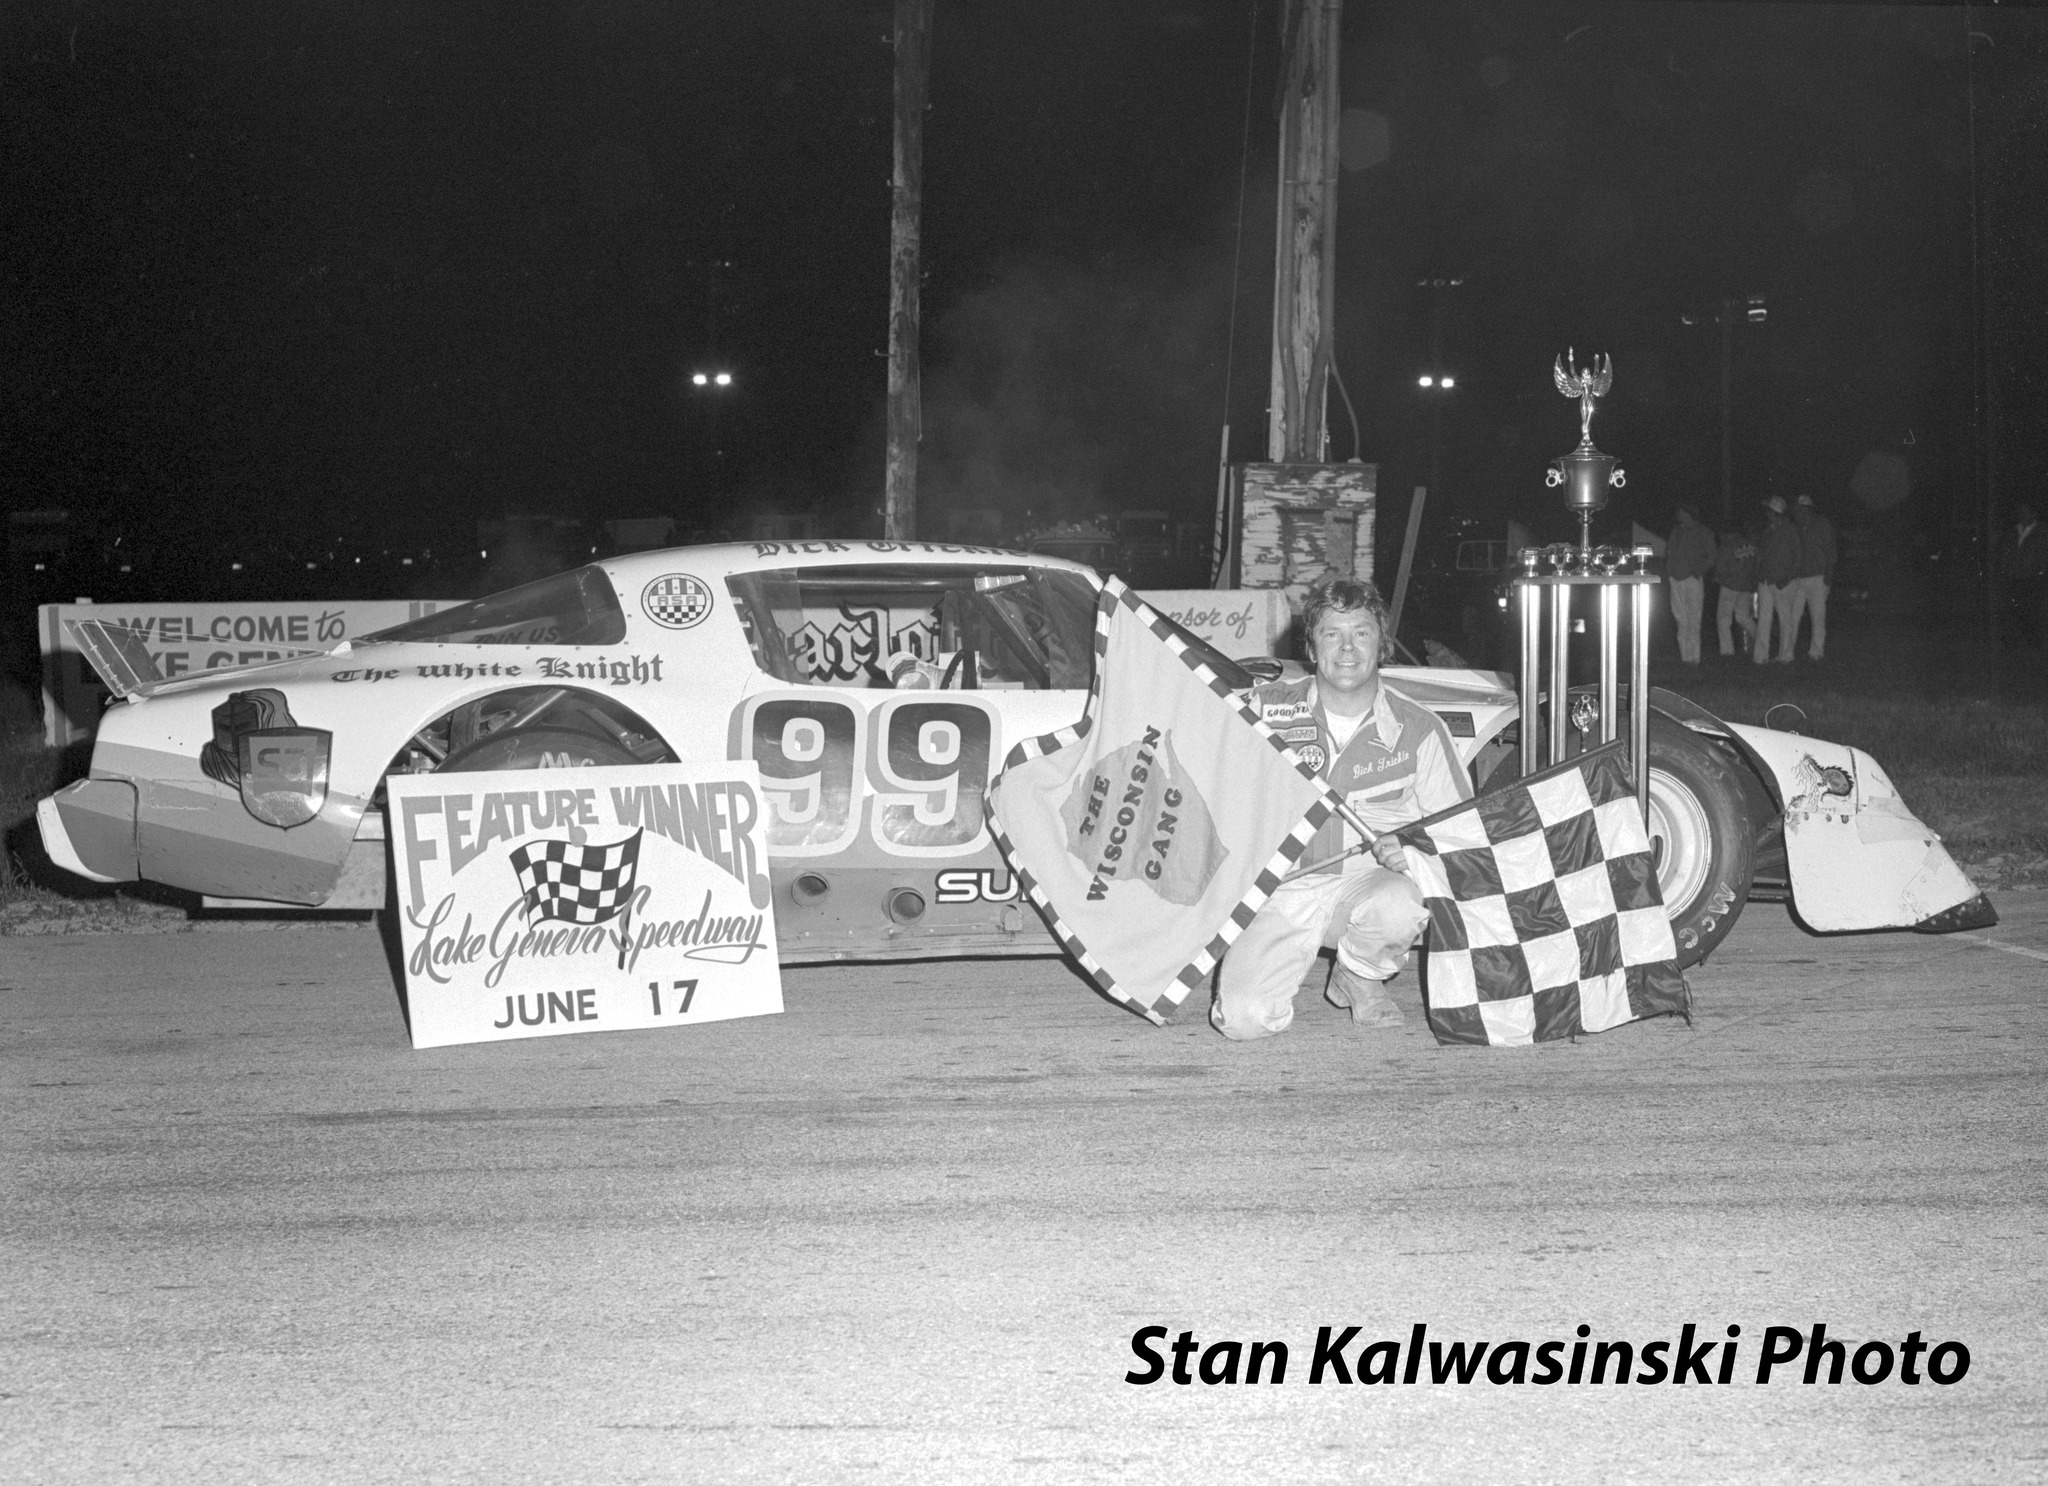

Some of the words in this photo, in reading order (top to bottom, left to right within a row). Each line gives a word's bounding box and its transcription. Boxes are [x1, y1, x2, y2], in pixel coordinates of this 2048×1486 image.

[657, 595, 698, 606] ASA
[118, 615, 310, 643] WELCOME
[315, 609, 346, 642] to
[529, 625, 559, 643] US
[1168, 606, 1222, 627] nsor
[1226, 602, 1254, 640] of
[330, 667, 401, 684] The
[535, 653, 664, 687] Knight
[1267, 704, 1309, 719] GOODYE
[736, 690, 1002, 858] 99
[1352, 762, 1374, 780] Dick
[1079, 774, 1111, 836] THE
[1086, 724, 1161, 901] WISCONSIN
[400, 787, 600, 918] FEATURE
[610, 780, 771, 910] WINNER
[1144, 787, 1183, 881] GANG
[935, 867, 1031, 905] SU
[405, 892, 487, 984] Lake
[484, 893, 607, 989] Geneva
[609, 884, 768, 974] Speedway
[494, 988, 599, 1029] JUNE
[648, 978, 700, 1017] 17
